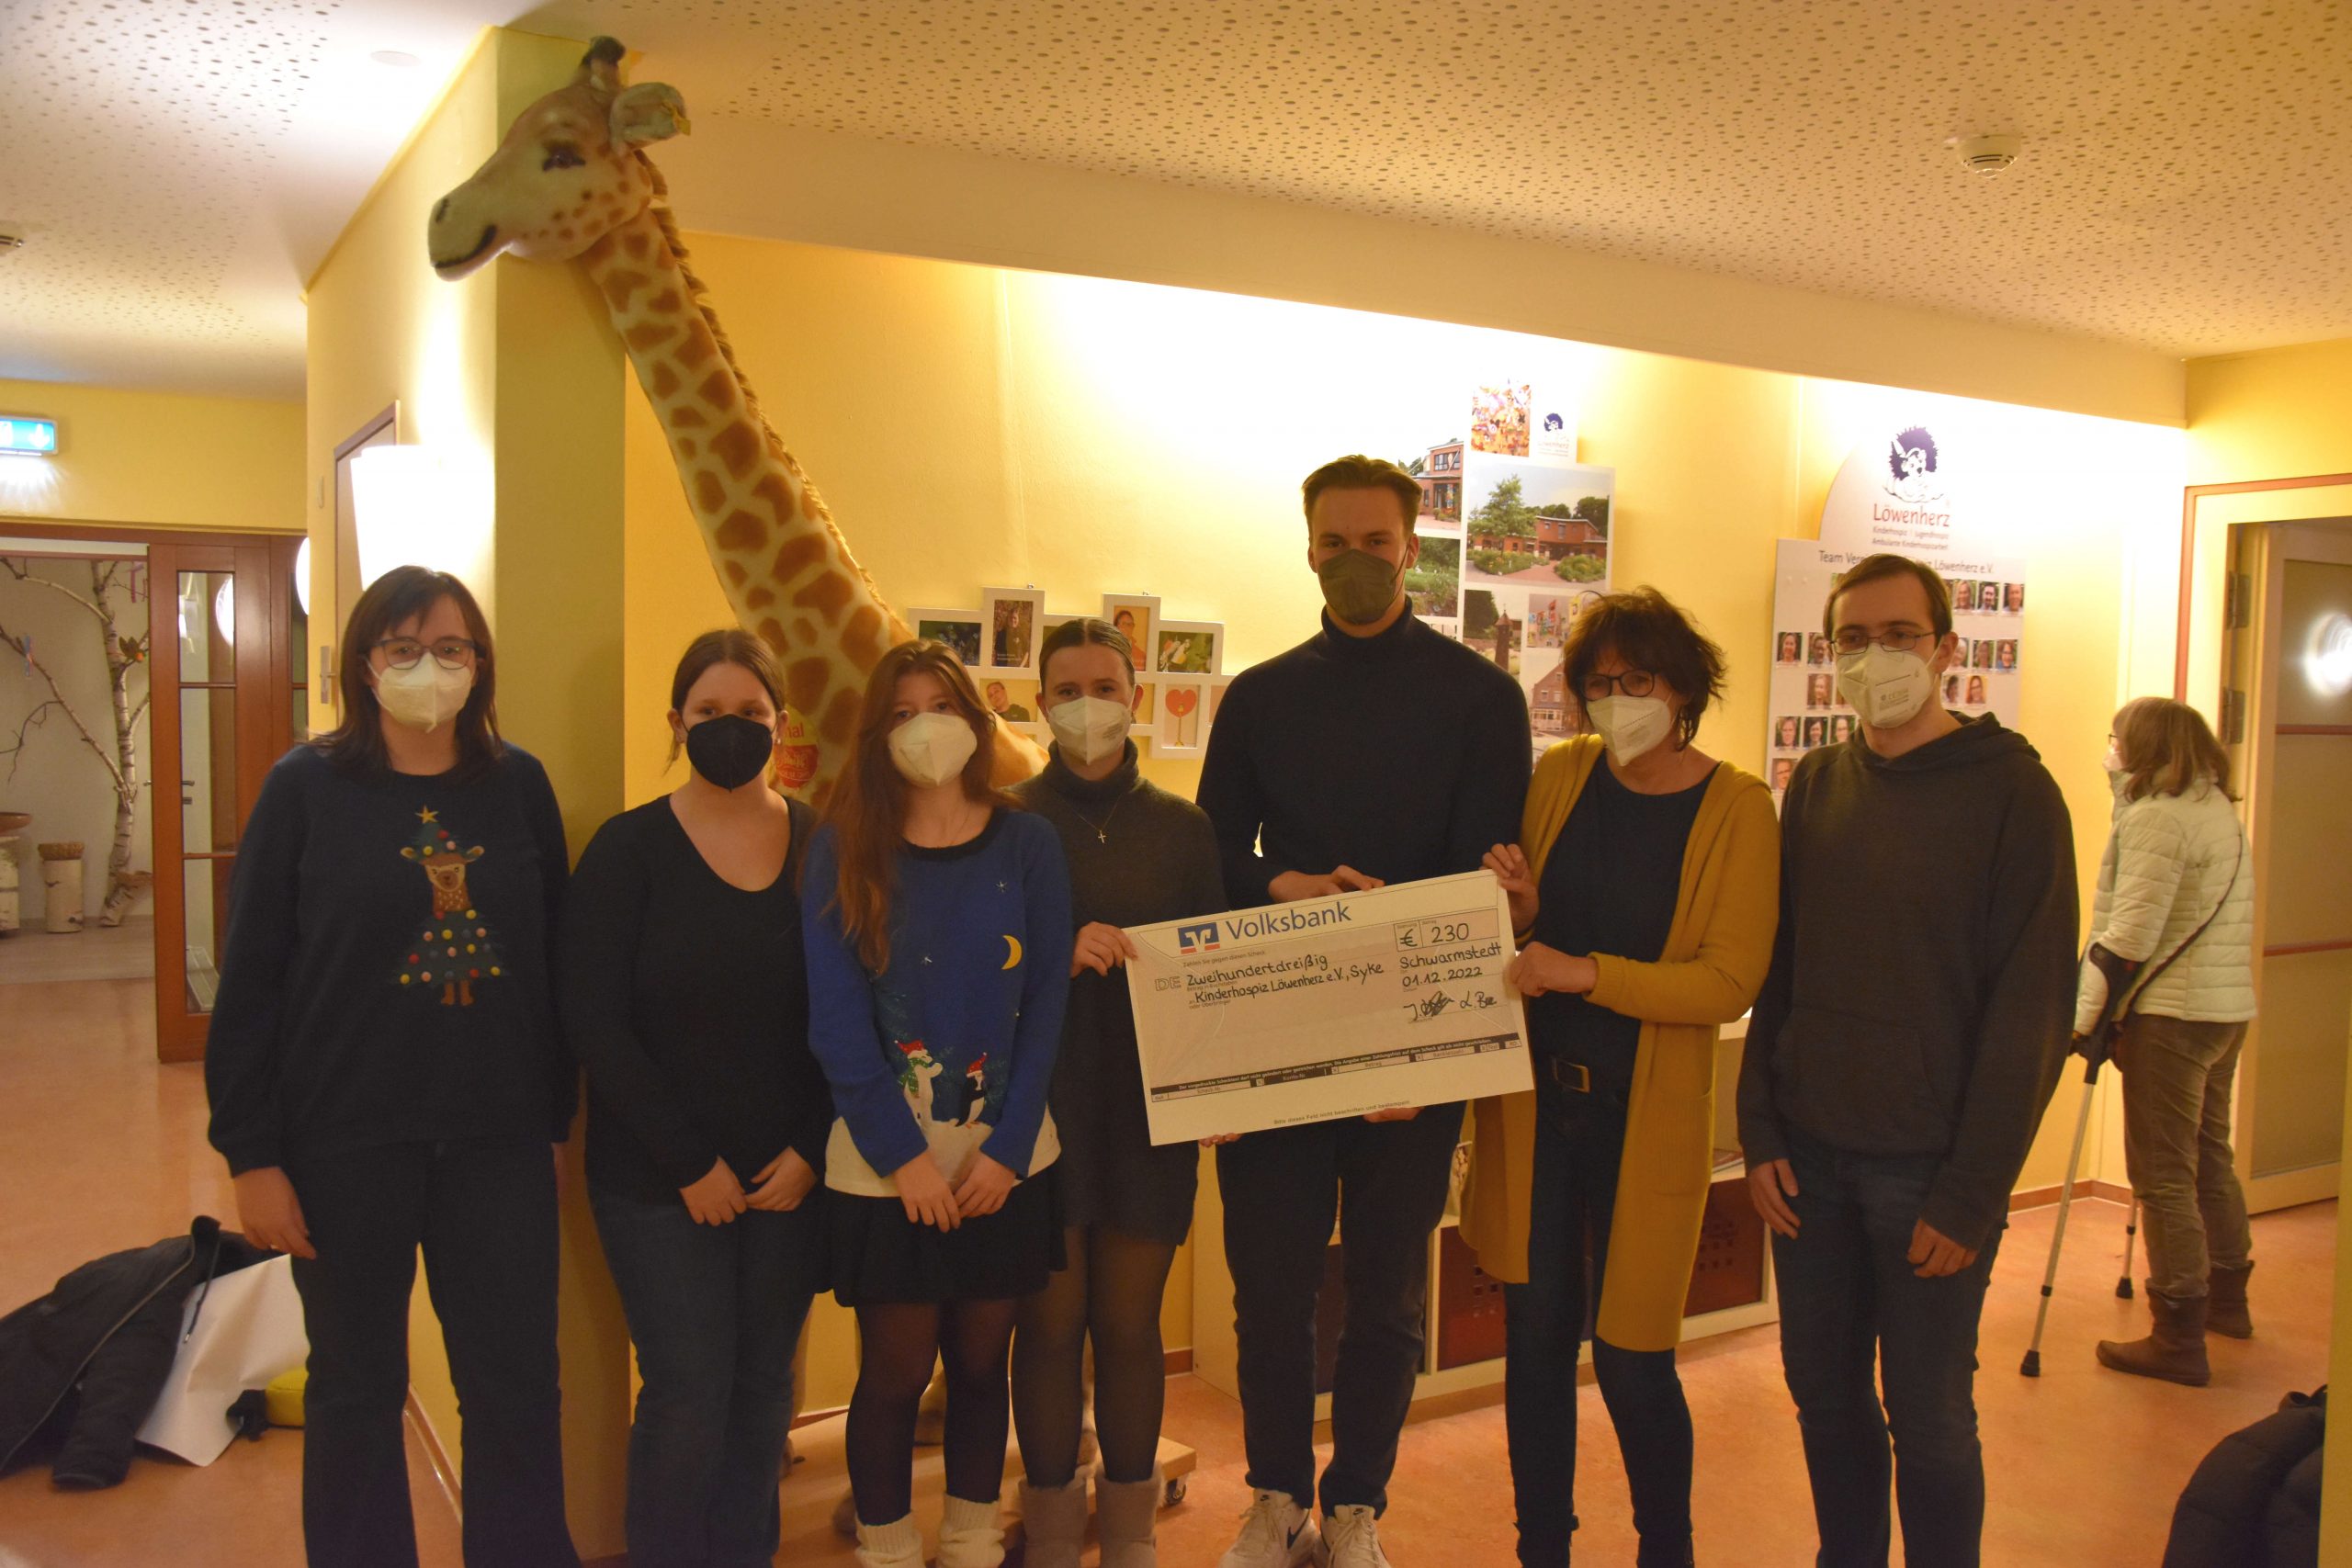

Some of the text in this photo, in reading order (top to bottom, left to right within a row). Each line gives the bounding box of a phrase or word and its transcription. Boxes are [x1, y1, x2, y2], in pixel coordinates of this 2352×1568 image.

[1873, 503, 1950, 527] Löwenherz
[1819, 550, 1843, 563] Team
[1935, 558, 1979, 573] Löwenherz
[1225, 901, 1352, 940] Volksbank
[1431, 923, 1469, 943] 230
[1400, 942, 1501, 969] Schwarmstedt
[1186, 953, 1329, 987] Zweihundertdreißig
[1402, 966, 1483, 987] 01.12.2022
[1155, 976, 1182, 991] DE
[1194, 983, 1269, 1003] Kinderhospiz
[1271, 975, 1324, 992] Löwenherz
[1351, 963, 1384, 985] Syke
